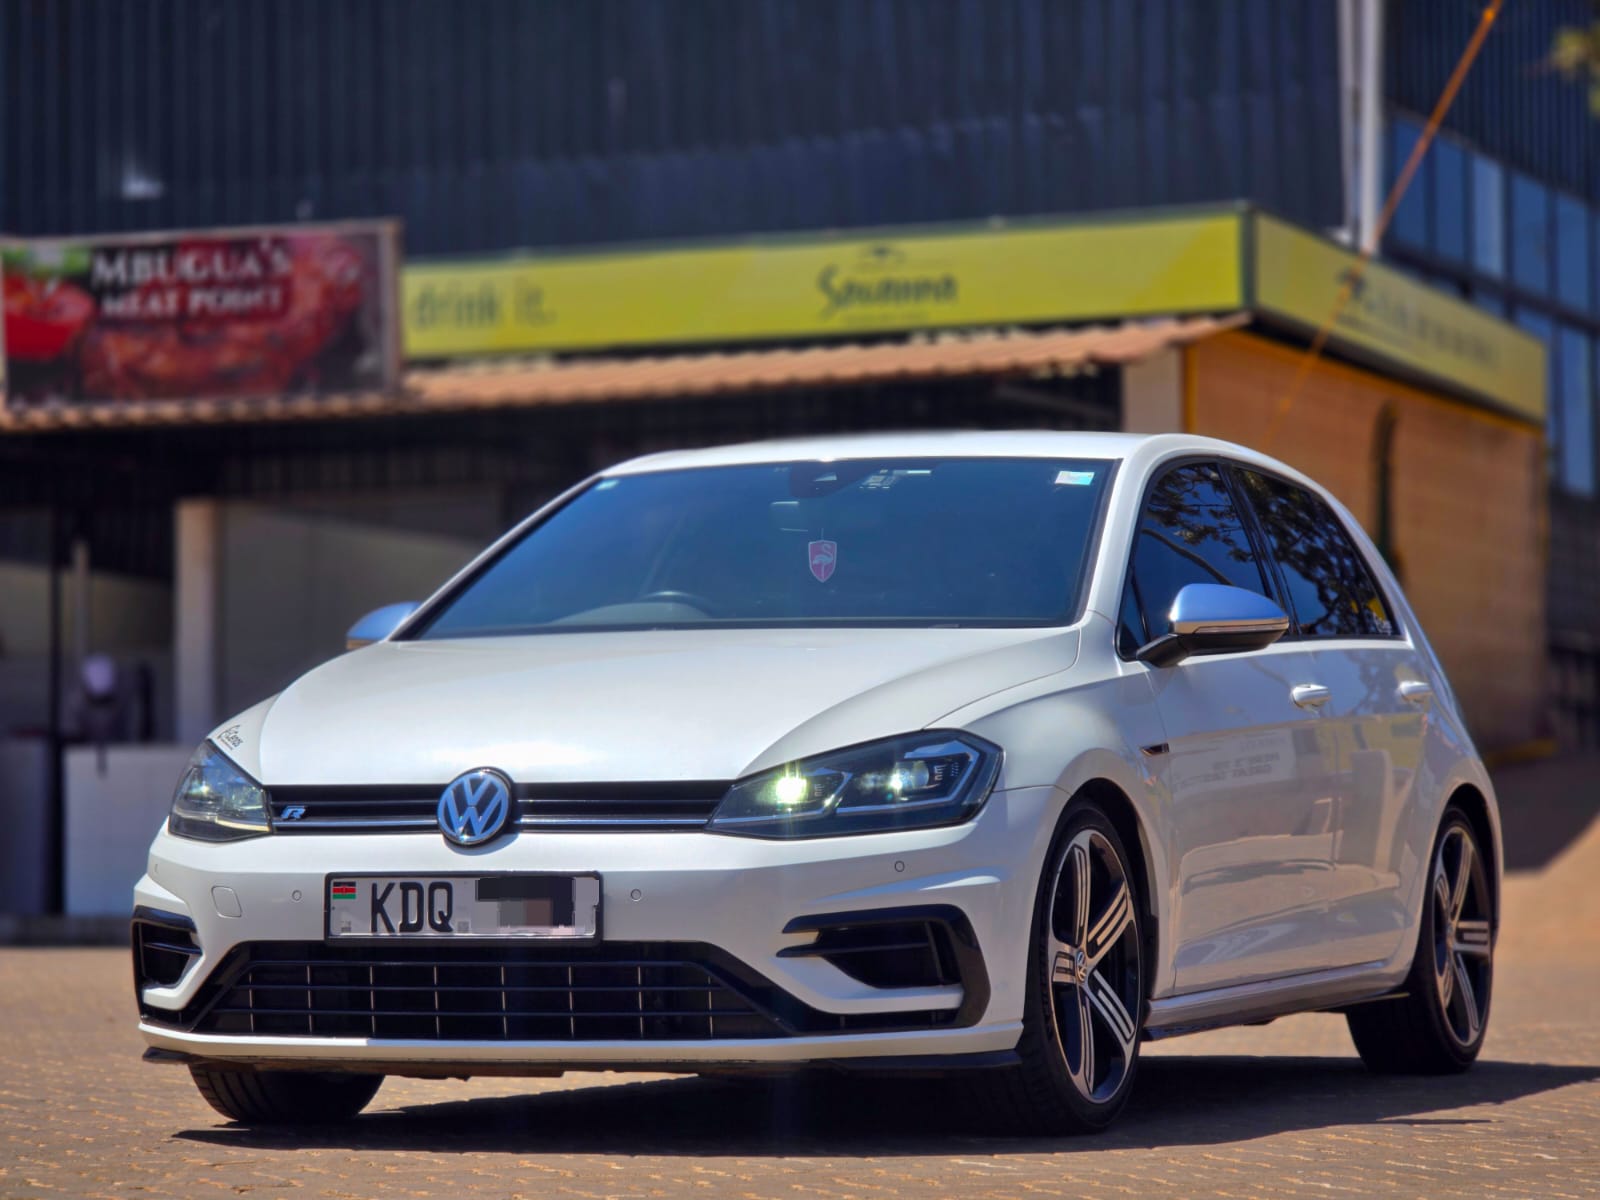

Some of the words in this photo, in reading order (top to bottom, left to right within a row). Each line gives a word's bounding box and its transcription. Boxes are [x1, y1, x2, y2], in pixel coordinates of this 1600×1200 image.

[92, 238, 290, 287] MBUGUA'S
[101, 288, 179, 317] MEAT
[188, 285, 282, 316] POINT
[280, 804, 306, 820] R
[371, 881, 453, 933] KDQ
